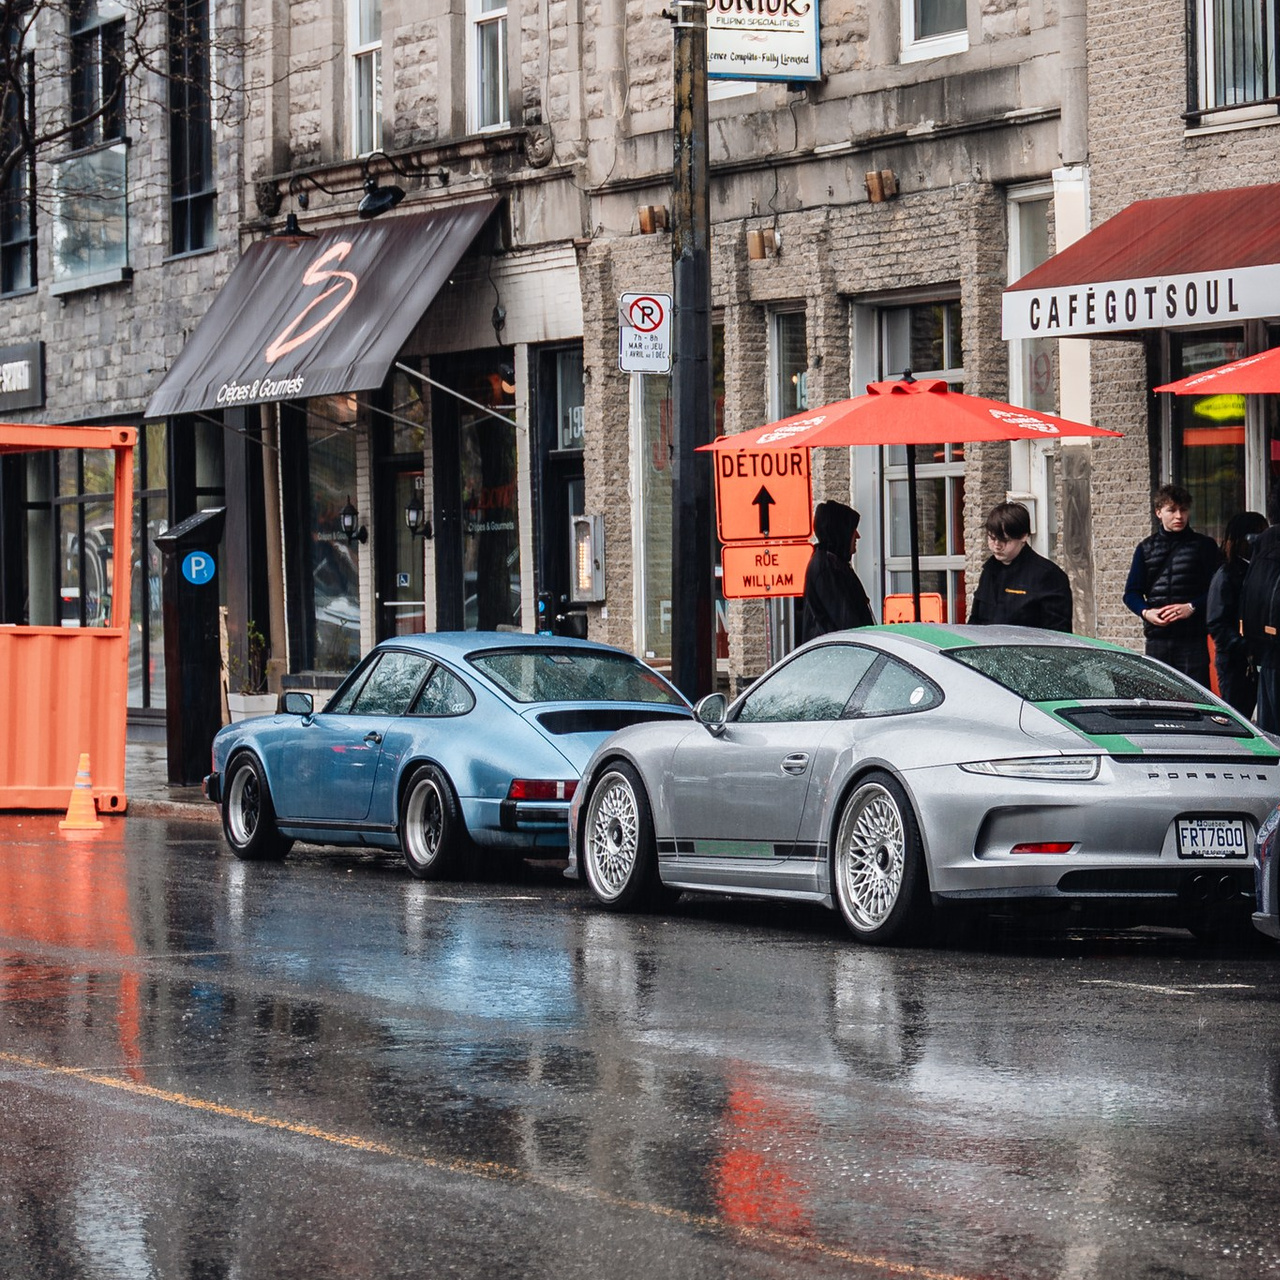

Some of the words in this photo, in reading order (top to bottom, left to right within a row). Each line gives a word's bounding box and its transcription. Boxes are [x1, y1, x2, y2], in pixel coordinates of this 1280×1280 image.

[629, 350, 644, 358] AVRIL
[216, 380, 250, 405] Crêpes
[249, 379, 259, 399] &
[721, 449, 803, 478] DÉTOUR
[742, 573, 794, 587] WILLIAM
[1147, 772, 1268, 781] PORSCHE
[1181, 827, 1243, 847] FRT7600
